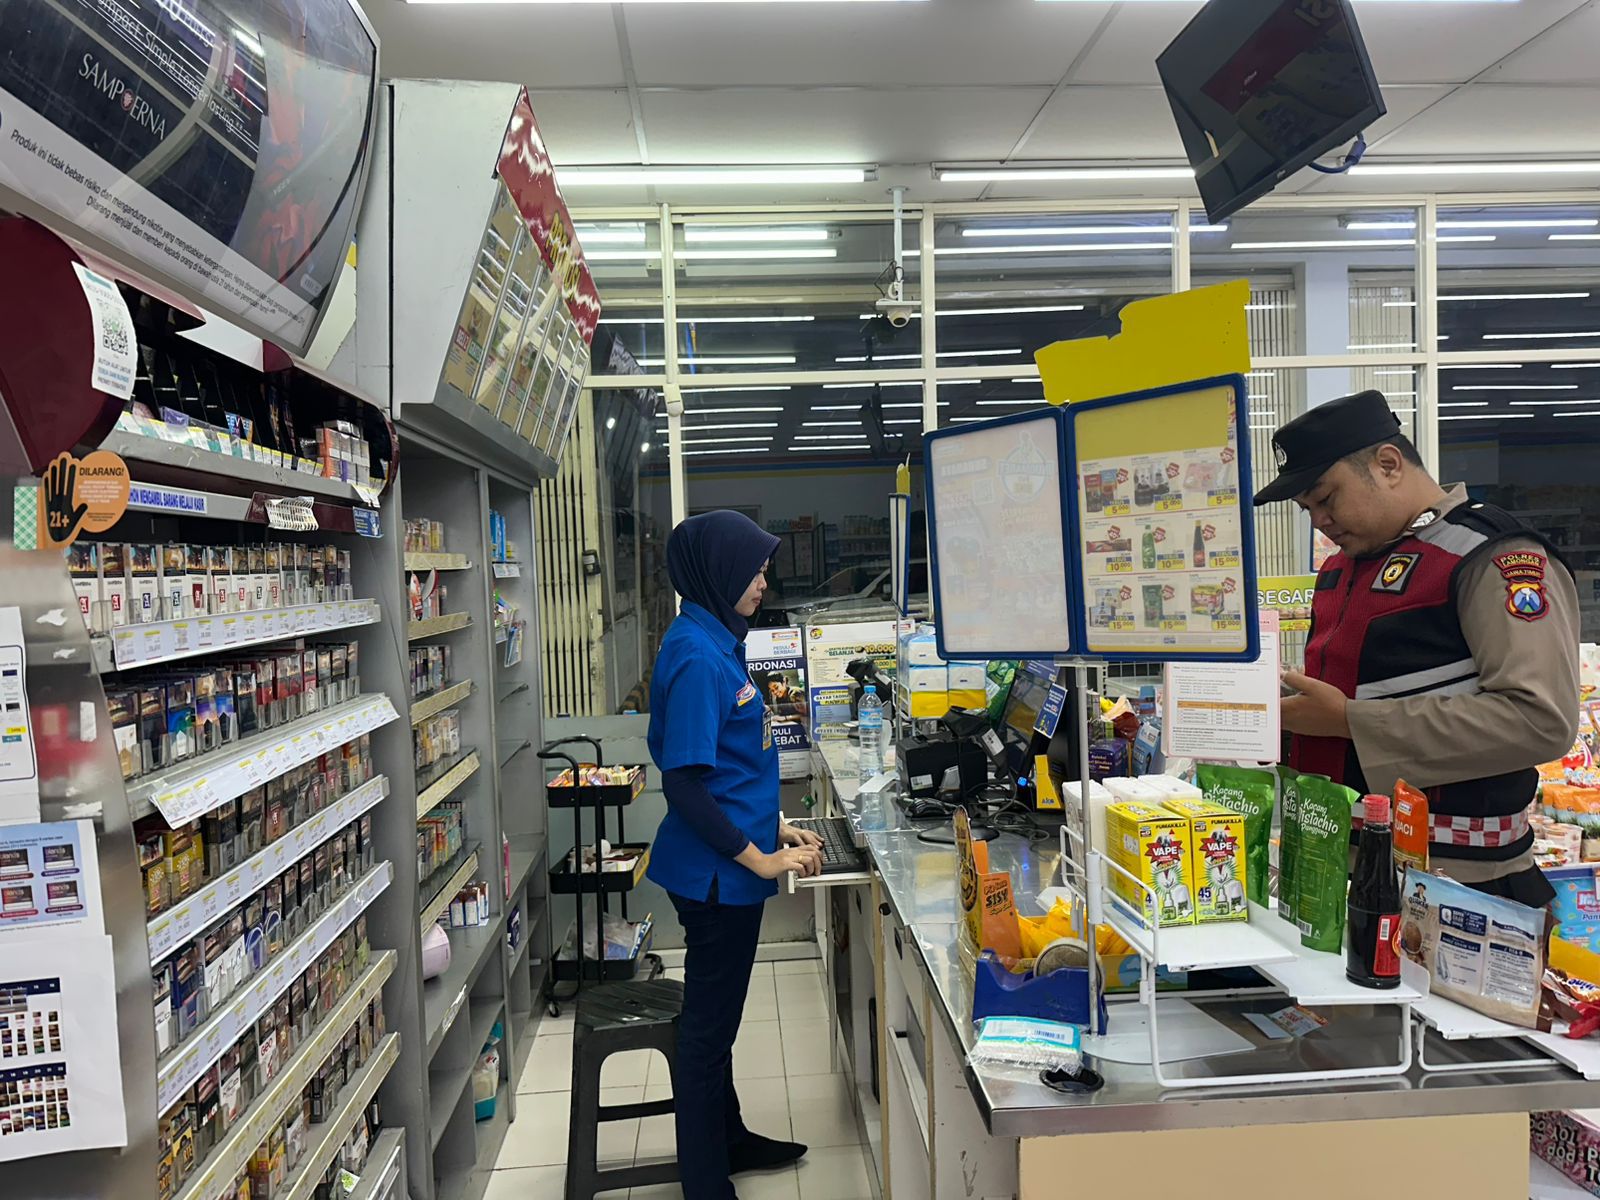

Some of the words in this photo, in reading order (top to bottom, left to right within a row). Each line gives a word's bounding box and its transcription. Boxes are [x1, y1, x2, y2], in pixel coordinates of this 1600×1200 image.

[11, 129, 37, 153] Produk
[37, 146, 47, 160] ini
[47, 152, 65, 171] tidak
[65, 165, 84, 184] bebas
[85, 177, 100, 194] risiko
[100, 188, 112, 201] dan
[112, 197, 146, 225] mengandung
[164, 230, 175, 243] yang
[86, 195, 111, 219] Dilarang
[79, 467, 125, 477] DILARANG!
[163, 493, 179, 509] BARANG
[194, 496, 204, 511] KASIR
[50, 511, 70, 528] 21+
[1500, 554, 1540, 563] POLRES
[1257, 588, 1314, 606] SEGAR
[865, 643, 895, 654] 10.000
[1213, 784, 1244, 799] Kacang
[1303, 798, 1328, 814] Kacang
[1301, 824, 1328, 838] Panggang
[1152, 846, 1177, 857] VAPE
[1207, 842, 1232, 852] VAPE
[1198, 887, 1211, 899] 45
[1551, 1126, 1577, 1145] TOY
[1547, 1143, 1576, 1162] POP
[1588, 1147, 1600, 1162] P
